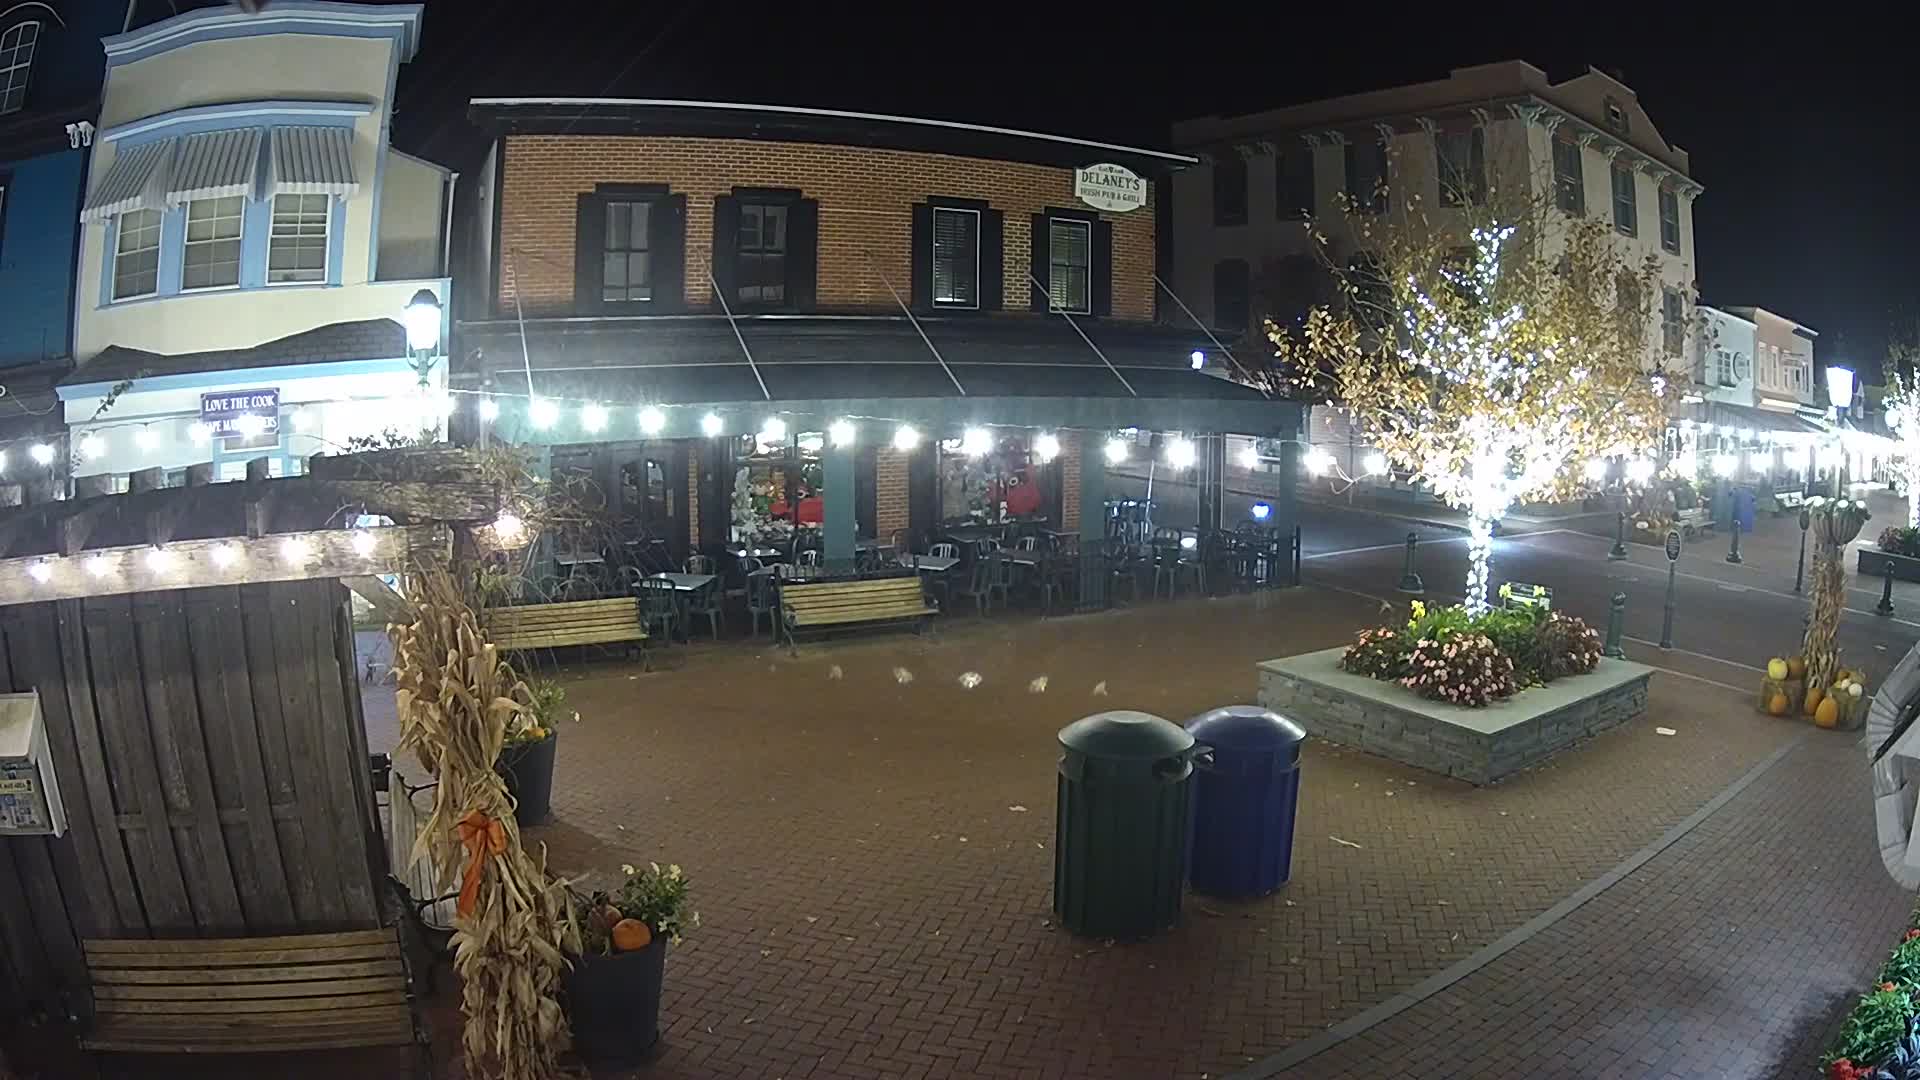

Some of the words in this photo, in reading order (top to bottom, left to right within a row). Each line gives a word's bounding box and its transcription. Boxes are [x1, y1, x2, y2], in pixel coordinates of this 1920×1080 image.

[205, 399, 229, 411] LOVE
[230, 397, 250, 410] THE
[251, 395, 275, 408] COOK
